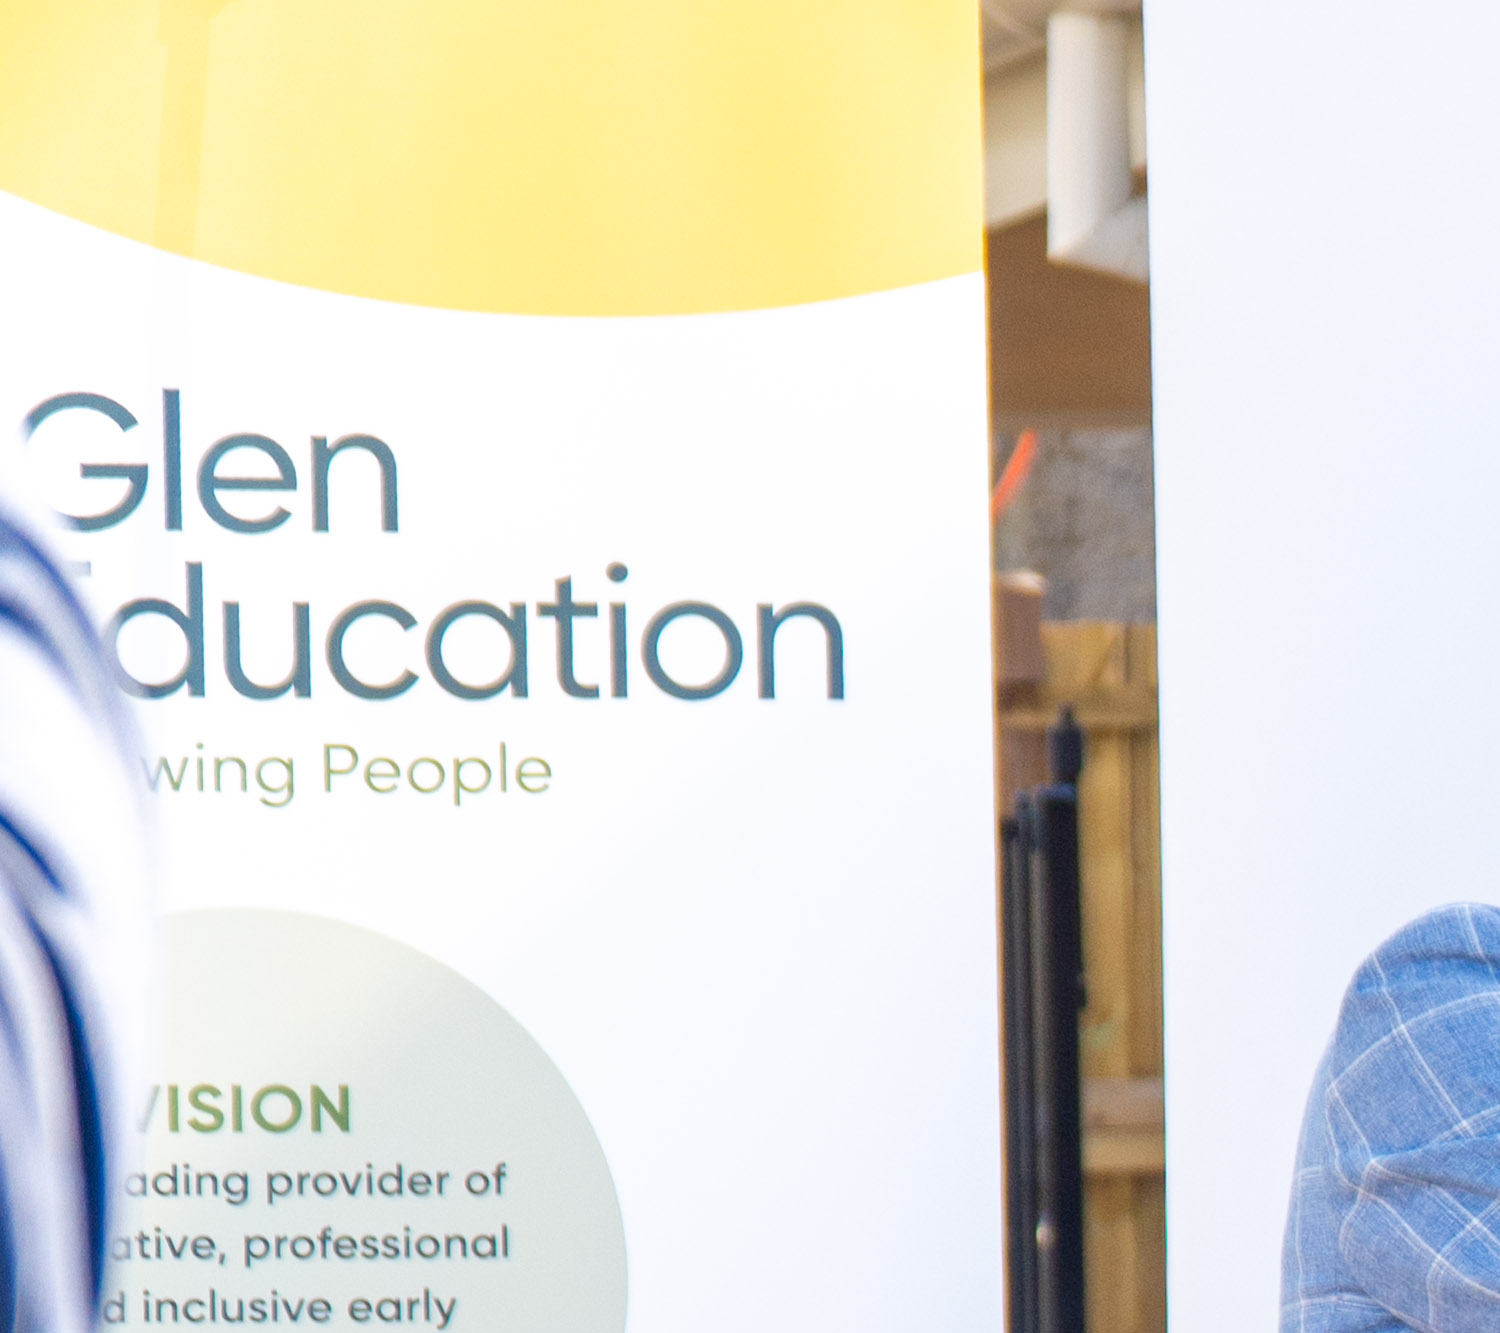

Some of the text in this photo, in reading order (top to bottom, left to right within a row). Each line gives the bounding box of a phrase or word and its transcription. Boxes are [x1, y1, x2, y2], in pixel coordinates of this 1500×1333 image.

[23, 387, 399, 534] Glen
[62, 559, 846, 702] ducation
[143, 743, 554, 808] wing People
[124, 1162, 508, 1205] ading provider of
[243, 1225, 510, 1266] professional
[142, 1290, 332, 1324] inclusive
[348, 1288, 457, 1330] early
